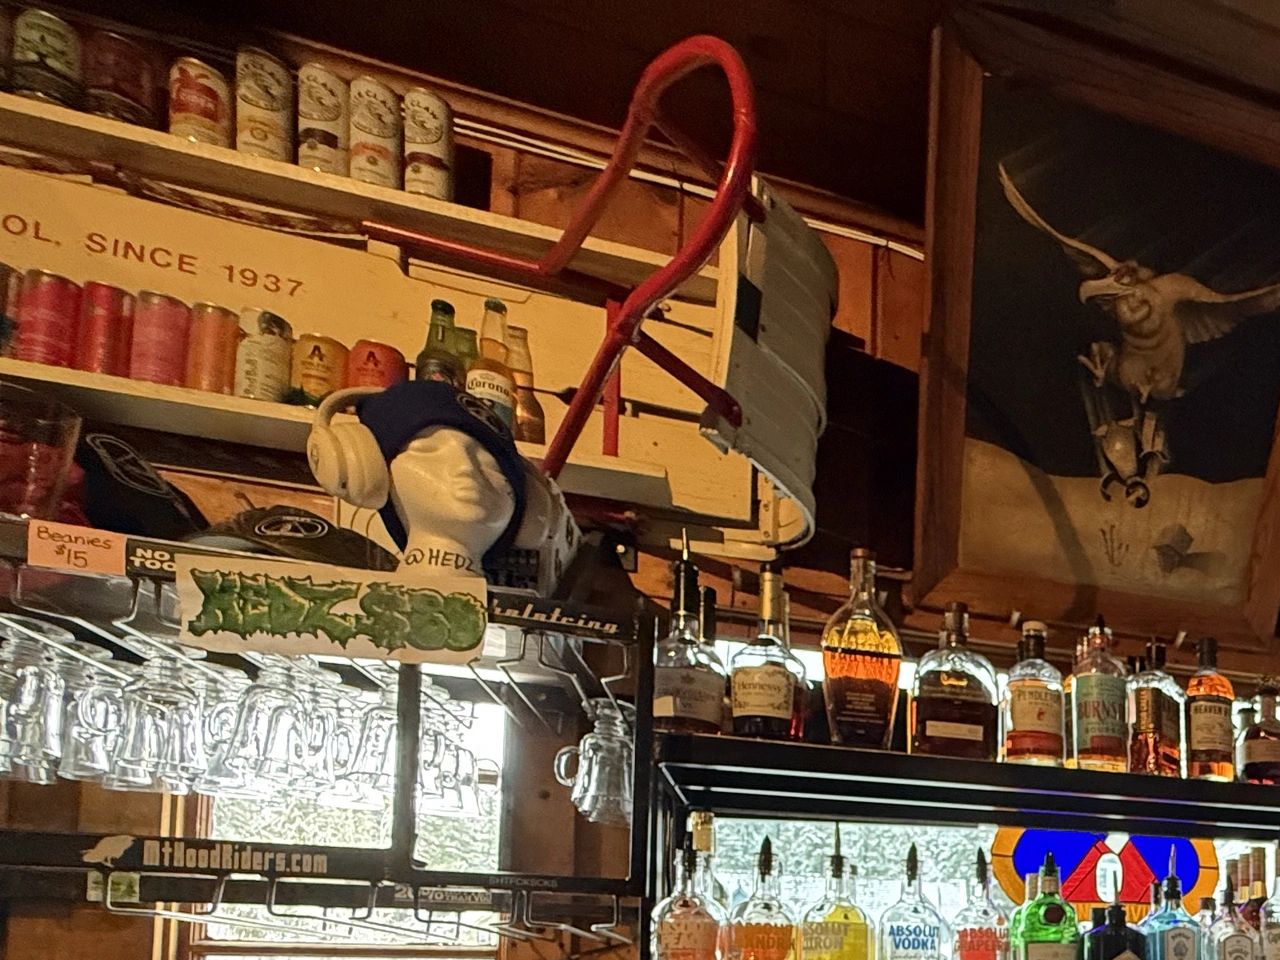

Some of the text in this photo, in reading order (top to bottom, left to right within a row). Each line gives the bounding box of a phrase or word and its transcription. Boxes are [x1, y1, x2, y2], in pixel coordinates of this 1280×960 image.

[85, 232, 198, 276] SINCE
[222, 264, 304, 297] 1937
[467, 375, 511, 397] Corona
[37, 525, 111, 550] Beanies
[55, 545, 88, 568] $15
[136, 548, 170, 561] NO
[143, 840, 328, 875] MtHoodRiders.com
[889, 925, 940, 938] ABSOLUT
[893, 938, 937, 951] VODKA
